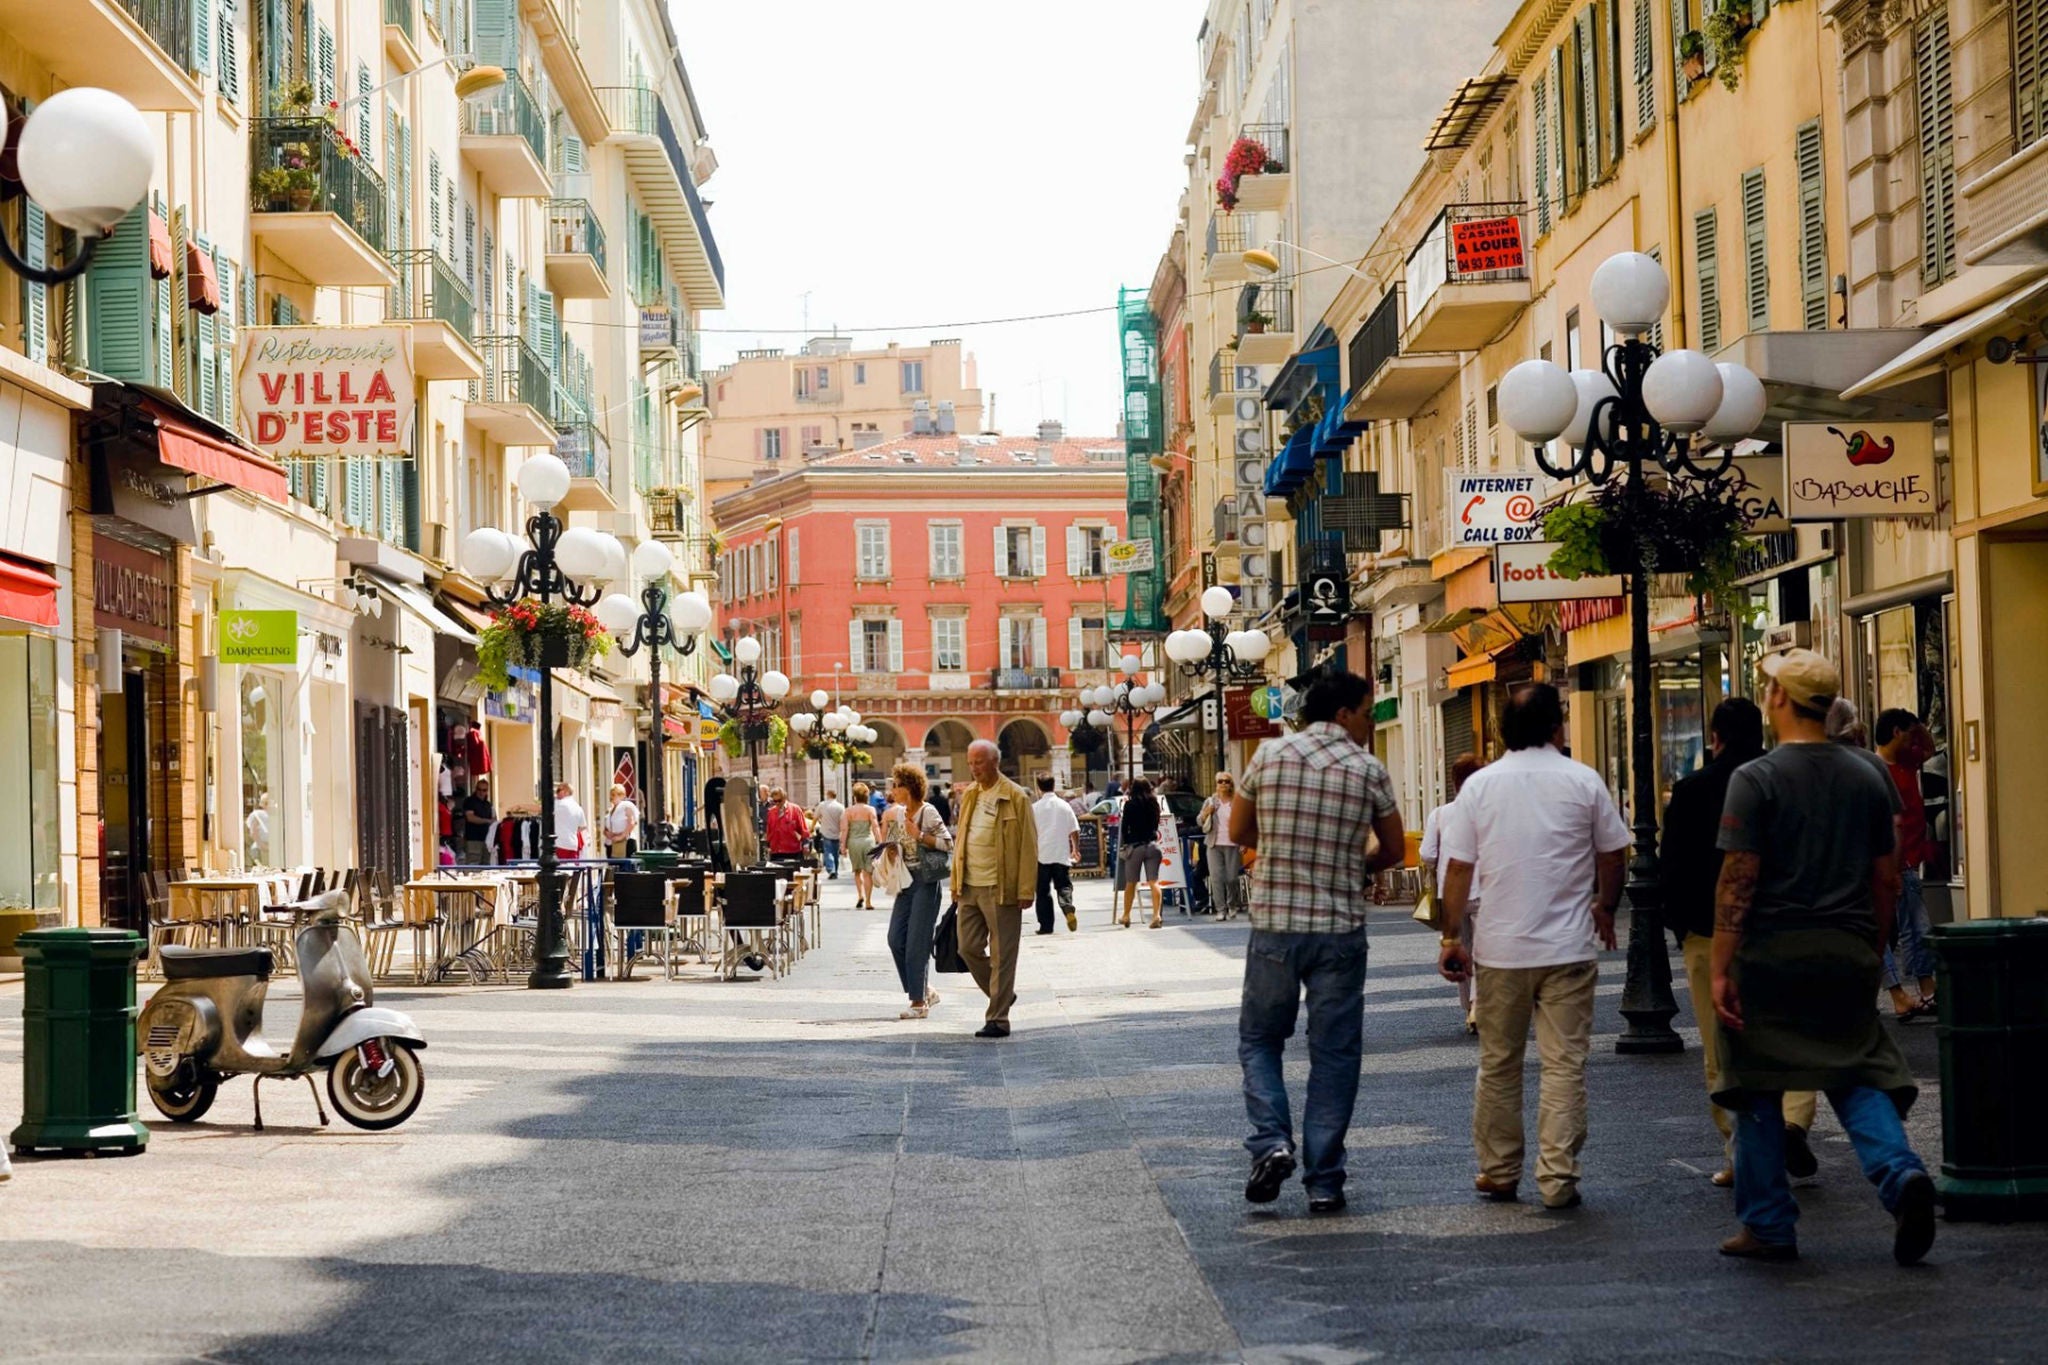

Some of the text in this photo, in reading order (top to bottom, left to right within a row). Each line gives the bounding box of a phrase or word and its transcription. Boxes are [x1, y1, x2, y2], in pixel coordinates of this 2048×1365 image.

[1458, 227, 1516, 240] CASSINI
[1463, 220, 1509, 231] GESTION
[1458, 237, 1519, 255] A LOUER
[1458, 259, 1470, 271] 04
[1472, 257, 1482, 269] 93
[1498, 254, 1508, 267] 17
[1511, 252, 1523, 265] 18
[257, 336, 396, 362] Ristorante
[258, 369, 396, 405] VILLA
[257, 409, 397, 445] D'ESTE
[1460, 477, 1534, 493] INTERNET
[1793, 474, 1930, 508] BABOUCHE
[1463, 526, 1533, 542] CALL BOX
[1502, 561, 1545, 582] foot
